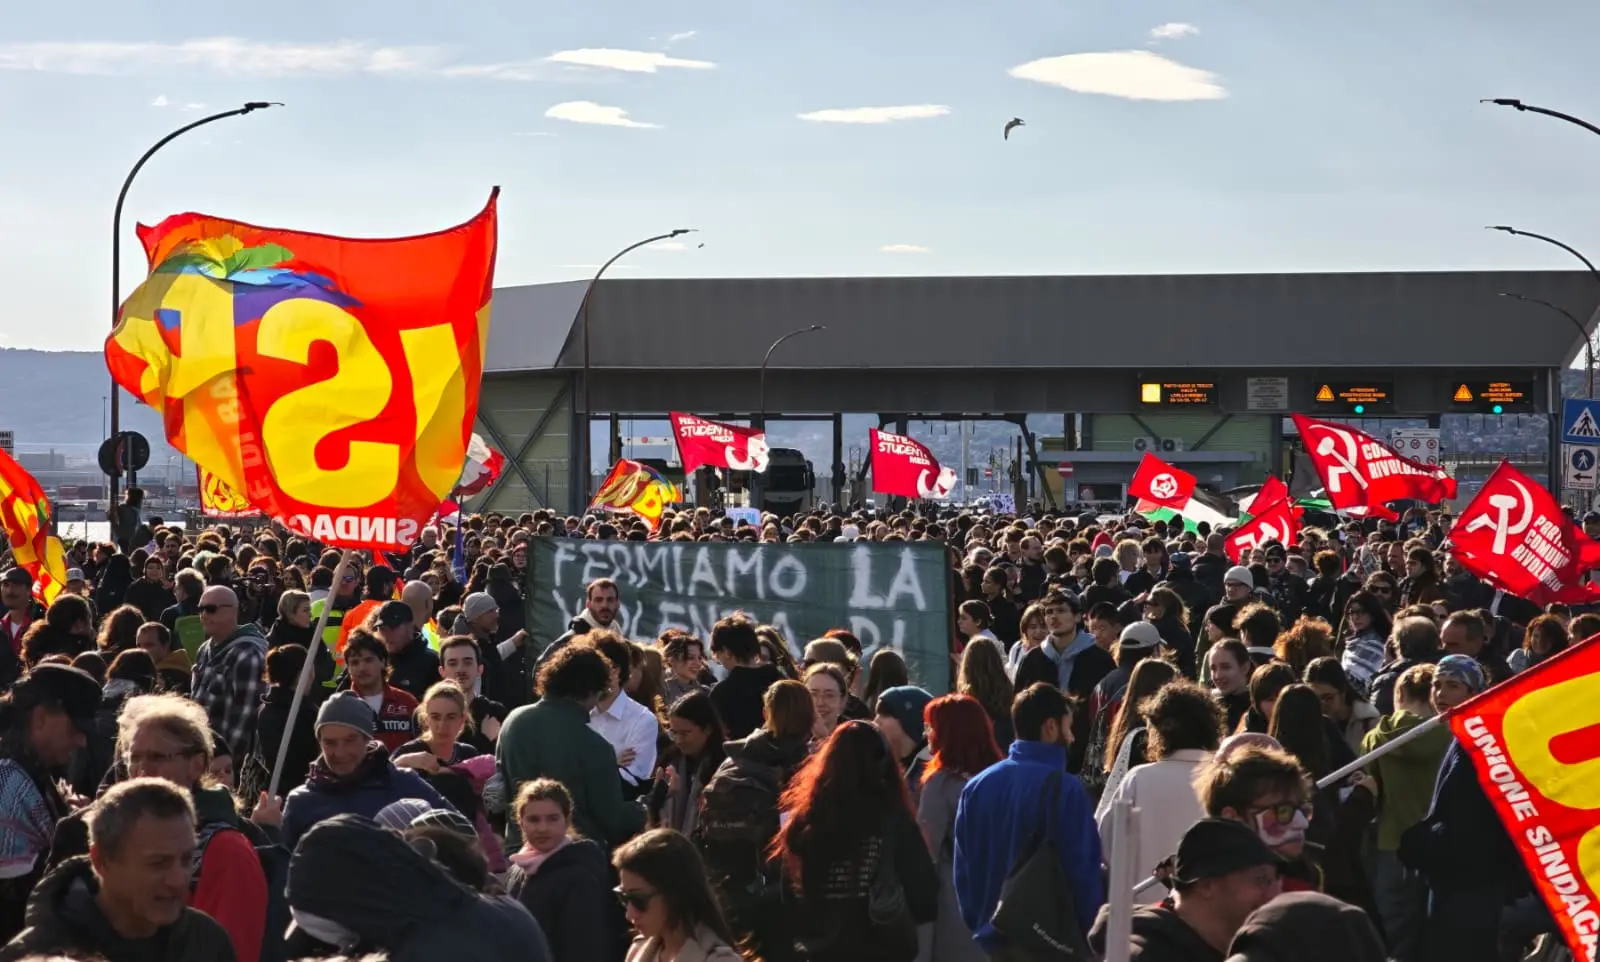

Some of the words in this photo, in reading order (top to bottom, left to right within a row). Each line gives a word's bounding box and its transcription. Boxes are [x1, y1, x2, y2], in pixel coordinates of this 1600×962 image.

[552, 542, 808, 599] FERMIAMO
[848, 545, 927, 611] LA
[1463, 715, 1539, 821] UNIONE
